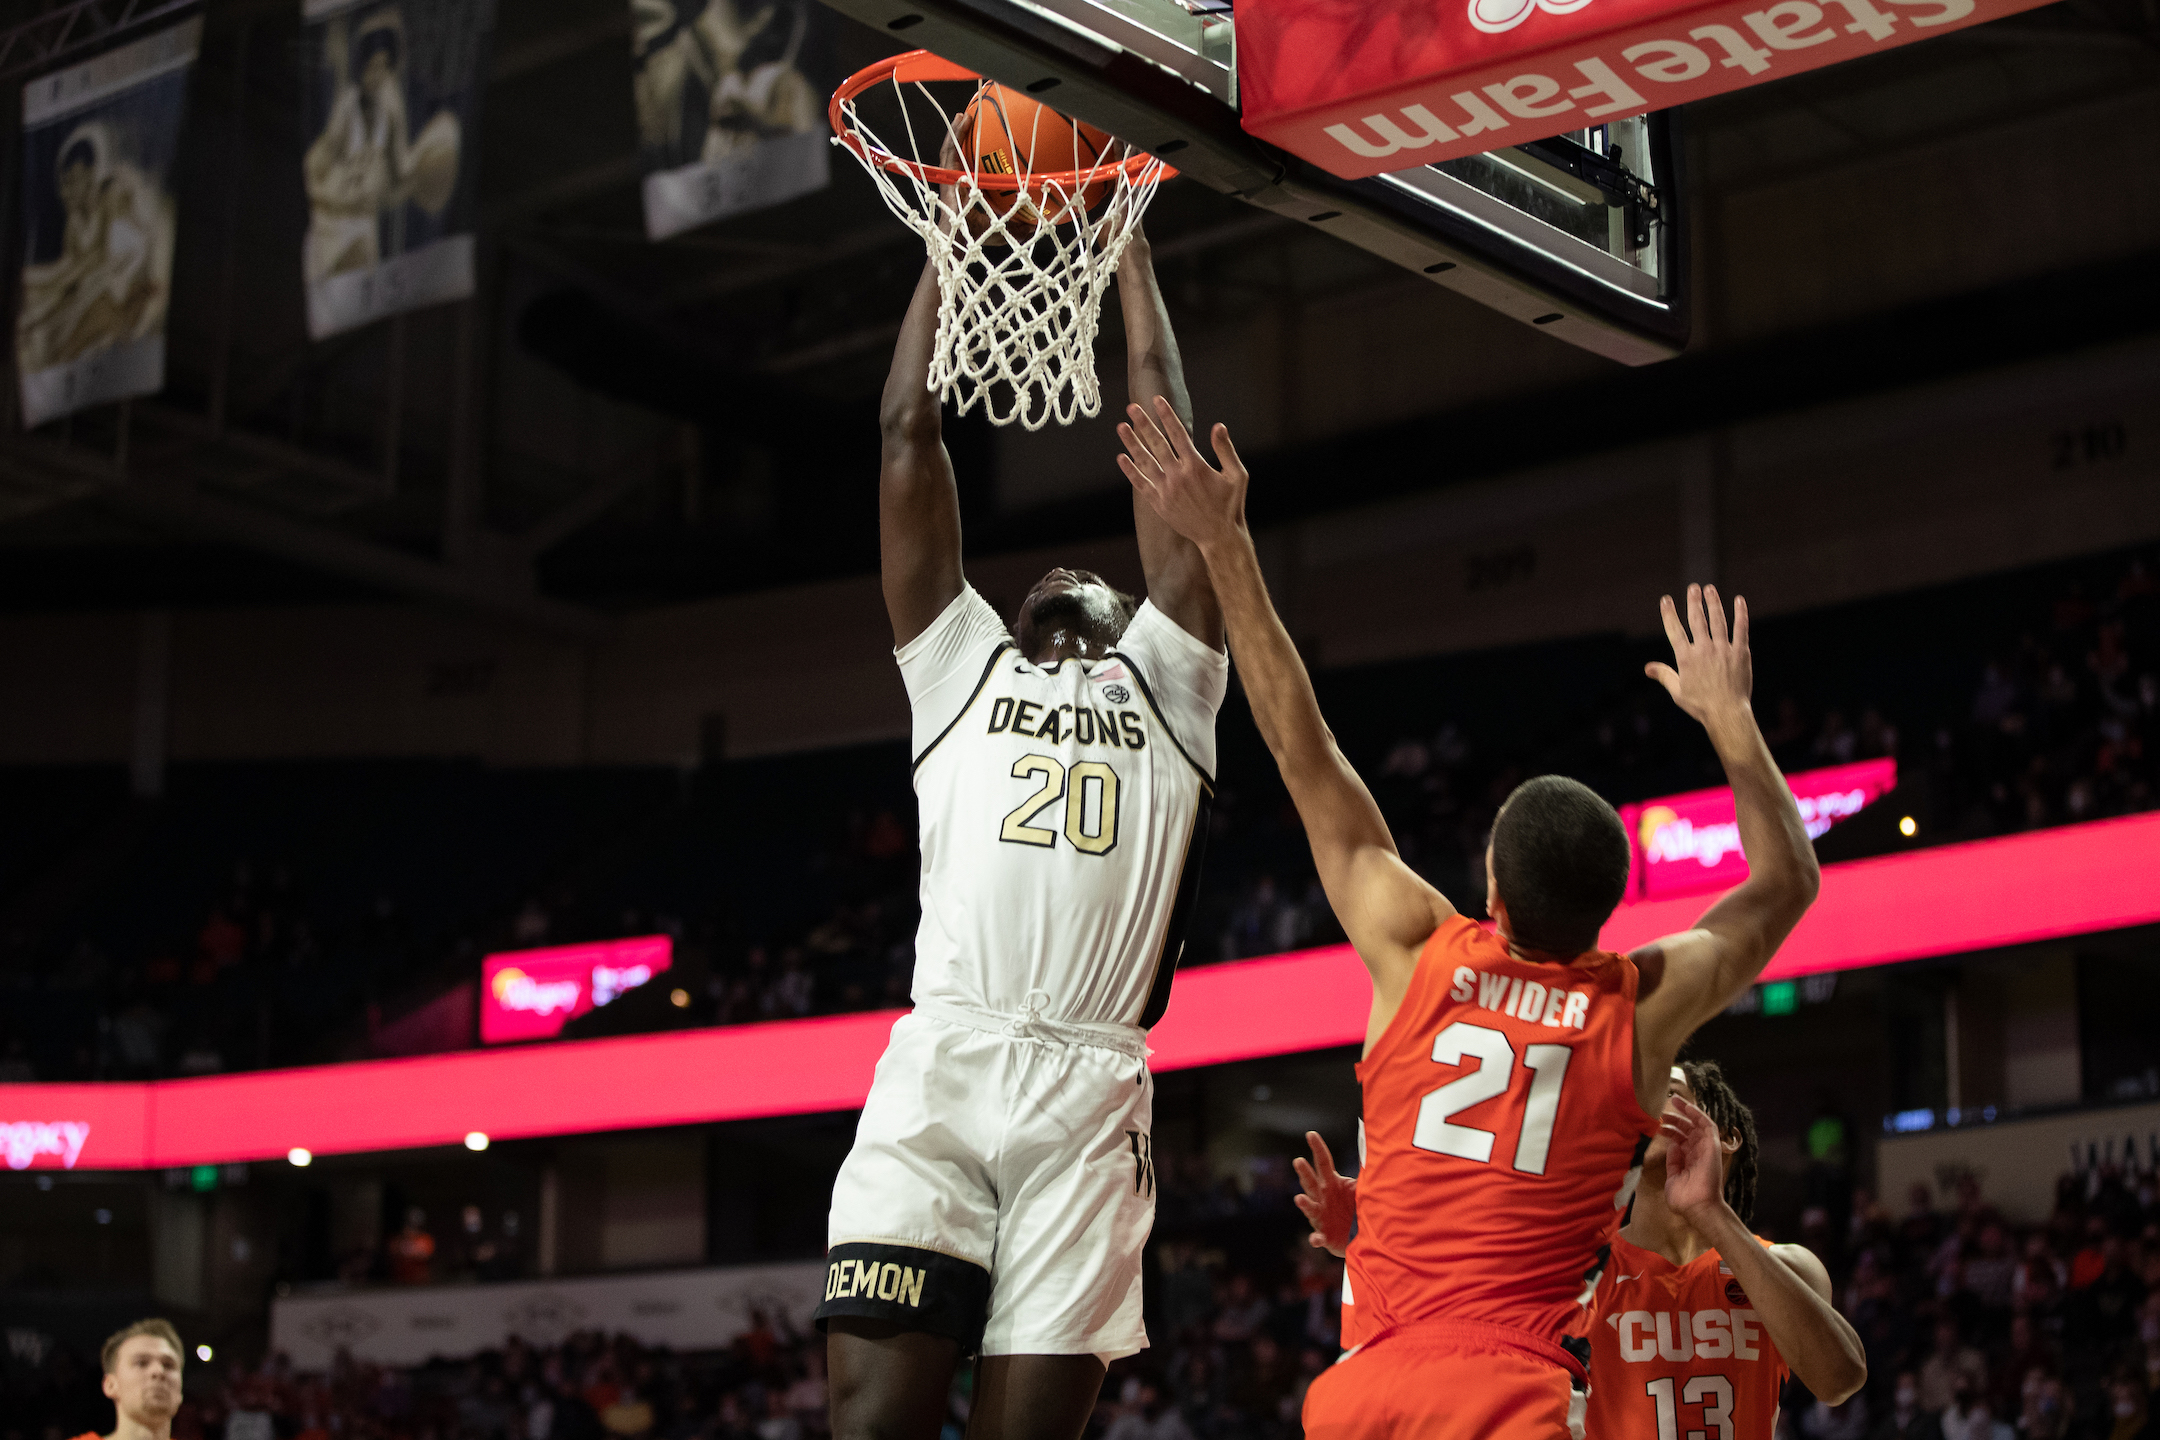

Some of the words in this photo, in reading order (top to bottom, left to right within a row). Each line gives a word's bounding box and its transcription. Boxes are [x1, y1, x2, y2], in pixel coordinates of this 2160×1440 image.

[987, 696, 1146, 751] DEACONS
[999, 753, 1121, 857] 20
[1451, 965, 1590, 1030] SWIDER
[1412, 1020, 1573, 1176] 21
[825, 1259, 926, 1307] DEMON
[1646, 1374, 1735, 1440] 13
